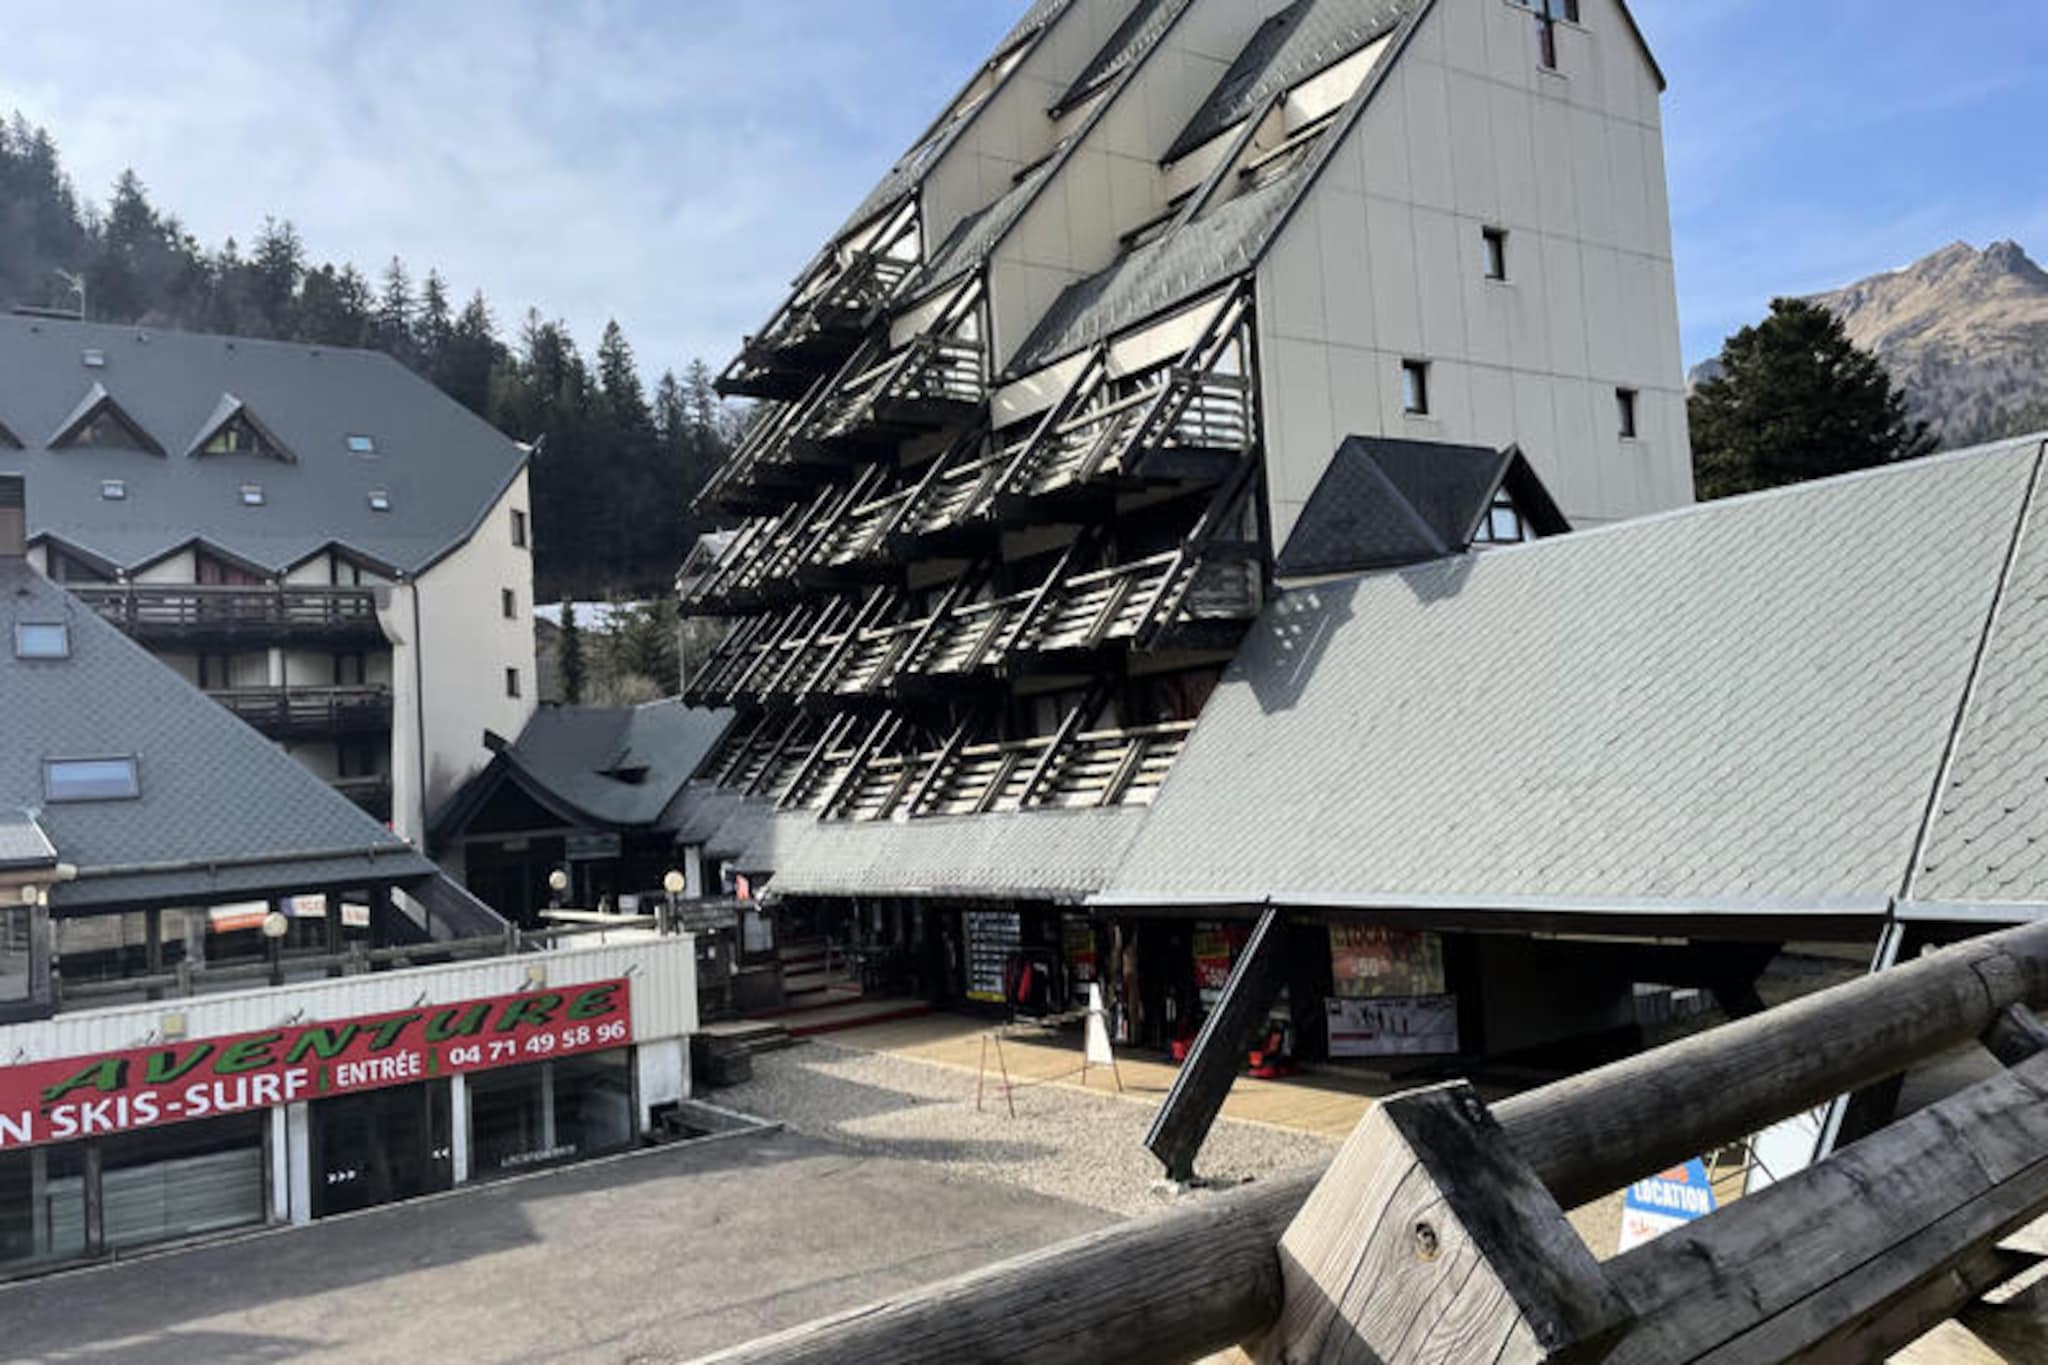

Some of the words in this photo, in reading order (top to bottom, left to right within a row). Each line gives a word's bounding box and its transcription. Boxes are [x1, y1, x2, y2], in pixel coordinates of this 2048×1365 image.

[41, 983, 621, 1101] AVENTURE
[449, 1046, 481, 1066] 04
[488, 1038, 516, 1061] 71
[525, 1032, 555, 1055] 49
[561, 1025, 591, 1049] 58
[596, 1018, 627, 1043] 96
[336, 1049, 421, 1087] ENTRÉE
[0, 1110, 32, 1145] N
[50, 1067, 309, 1138] SKIS-SURF
[1634, 1179, 1711, 1215] LOCATION
